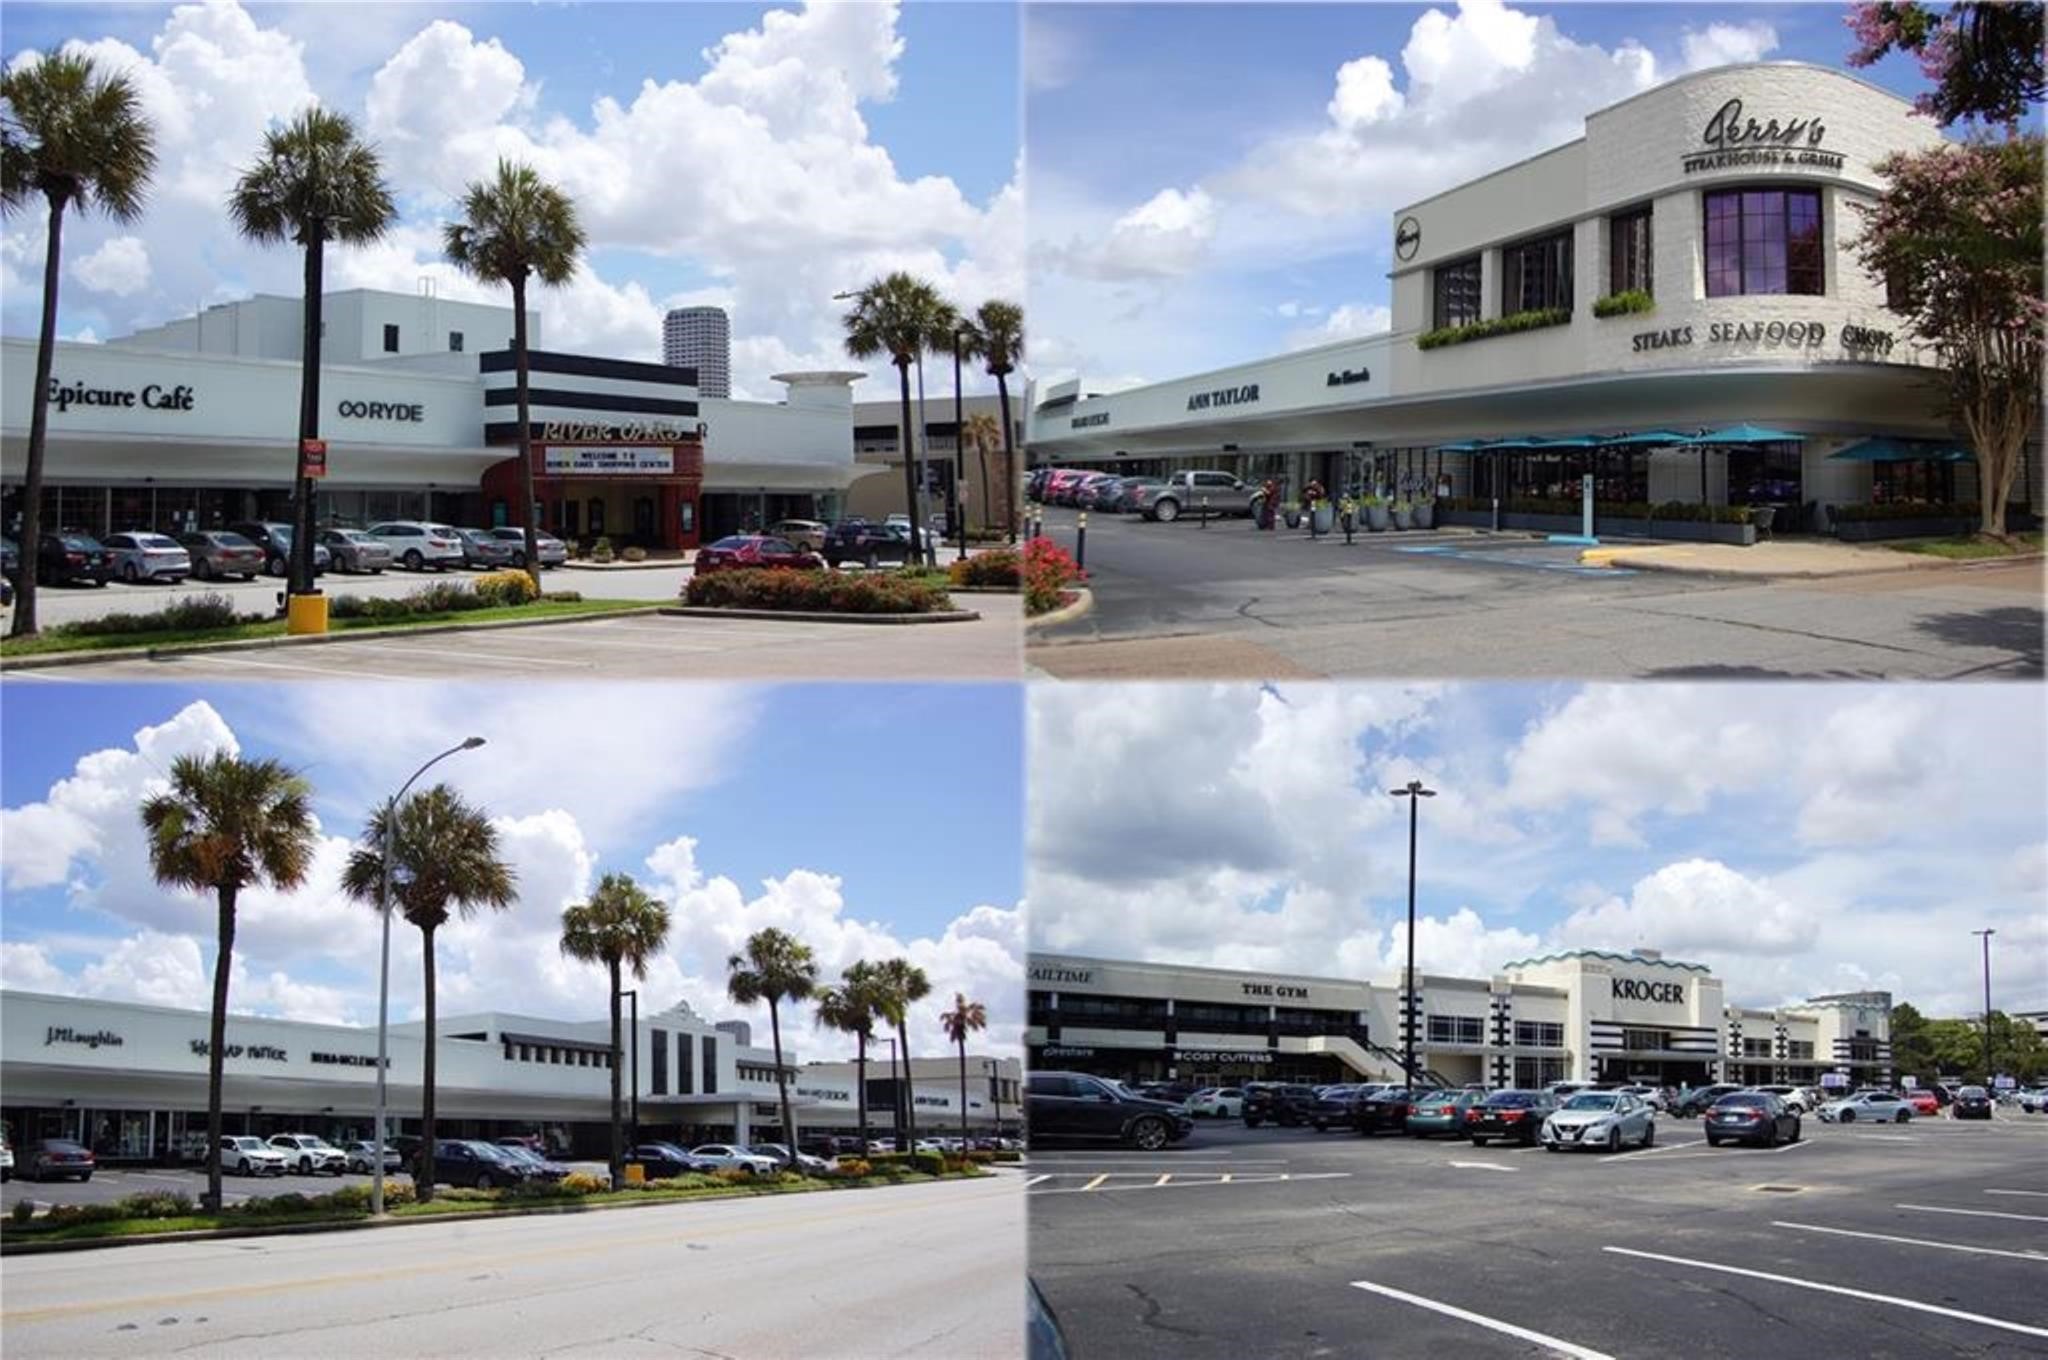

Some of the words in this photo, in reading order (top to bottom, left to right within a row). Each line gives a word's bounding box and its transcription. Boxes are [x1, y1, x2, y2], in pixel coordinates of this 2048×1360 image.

[1683, 152, 1780, 174] STEAKHOUSE
[1632, 326, 1694, 352] STEAKS
[1709, 320, 1826, 347] SEAFOOD
[1842, 323, 1894, 354] CHOPS
[48, 377, 136, 412] Epicure
[141, 384, 195, 410] Café
[1186, 394, 1211, 411] ANN
[1212, 384, 1260, 408] TAYLOR
[542, 421, 612, 440] RIVER
[619, 419, 682, 440] OAKS
[1242, 983, 1273, 996] THE
[1276, 986, 1308, 998] GYM
[1611, 978, 1684, 1004] KROGER
[1182, 1052, 1218, 1062] COST
[1219, 1053, 1273, 1063] CUTTERS
